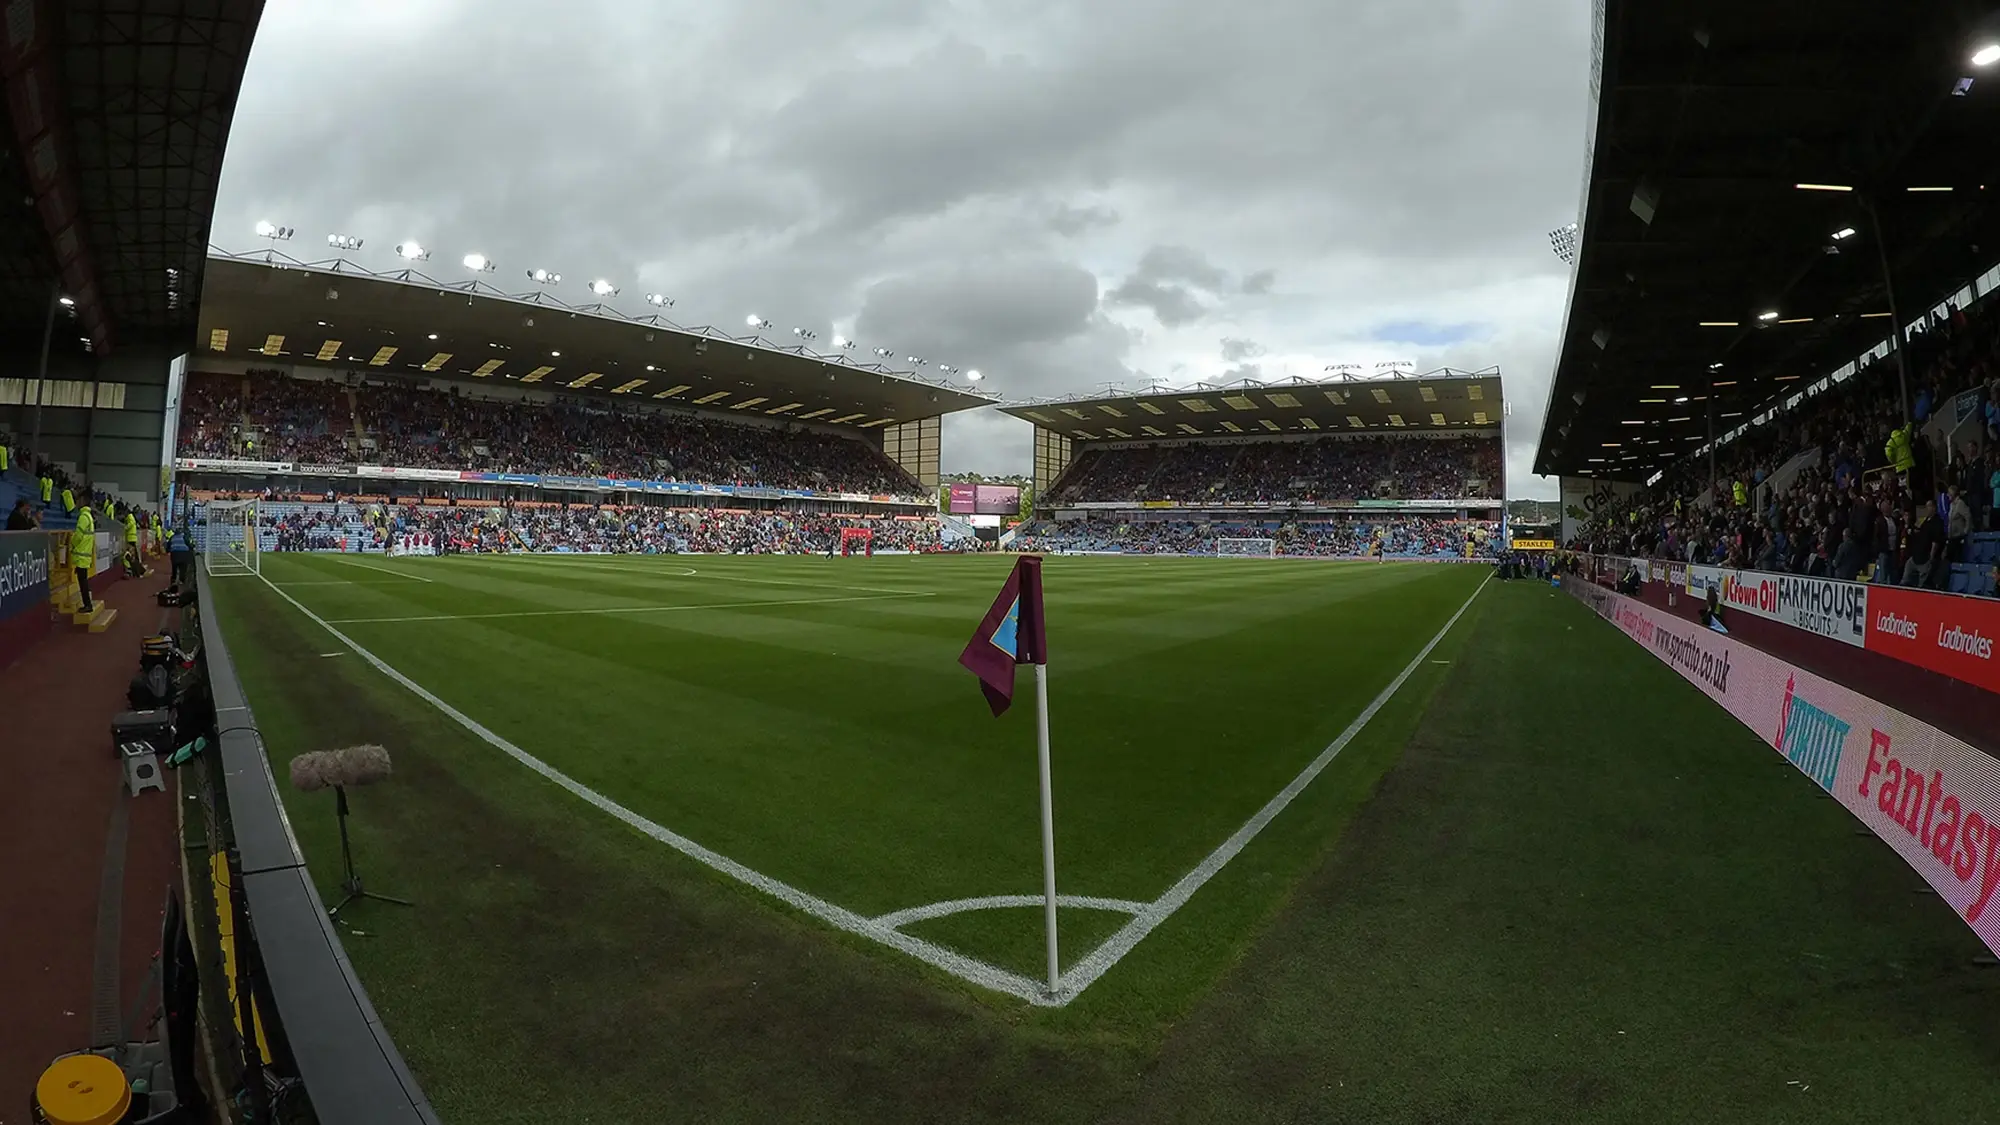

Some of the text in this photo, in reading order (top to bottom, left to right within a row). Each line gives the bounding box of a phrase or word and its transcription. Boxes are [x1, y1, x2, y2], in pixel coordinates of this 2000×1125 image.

[13, 552, 28, 592] Bed
[28, 549, 47, 586] Brand
[1730, 575, 1758, 608] Crown
[1760, 579, 1777, 614] Oil
[1778, 577, 1864, 636] FARMHOUSE
[1799, 610, 1832, 636] BISCUITS
[1876, 608, 1918, 640] Ladbrokes
[1937, 621, 1994, 660] Ladbrokes
[1655, 624, 1731, 694] www.sportito.co.uk
[1858, 727, 2000, 924] Fantasy
